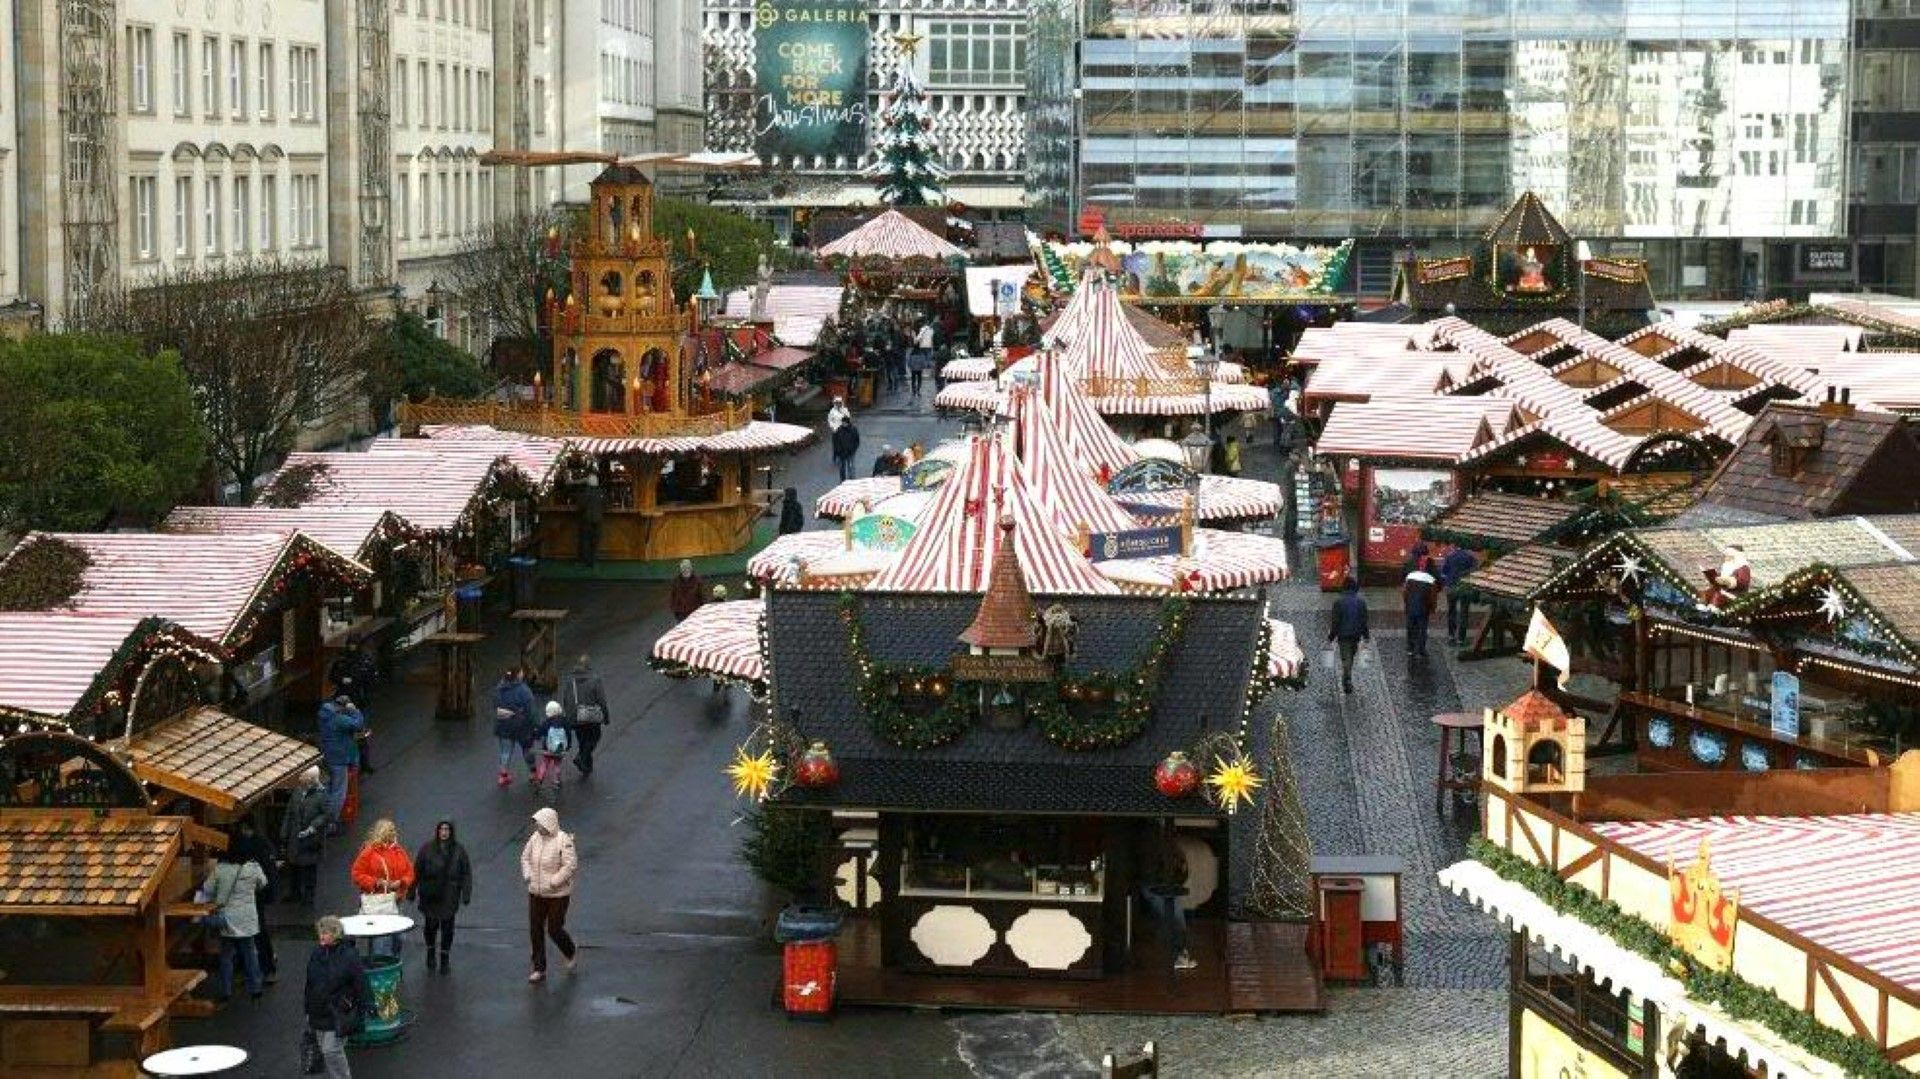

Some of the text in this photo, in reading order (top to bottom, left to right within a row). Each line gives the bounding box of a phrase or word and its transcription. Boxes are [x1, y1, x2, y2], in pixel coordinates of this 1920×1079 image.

[785, 8, 868, 22] GALERIA
[778, 42, 834, 58] COME
[793, 59, 842, 74] BACK
[782, 75, 818, 89] FOR
[787, 90, 842, 105] MORE
[756, 92, 867, 136] Christmas
